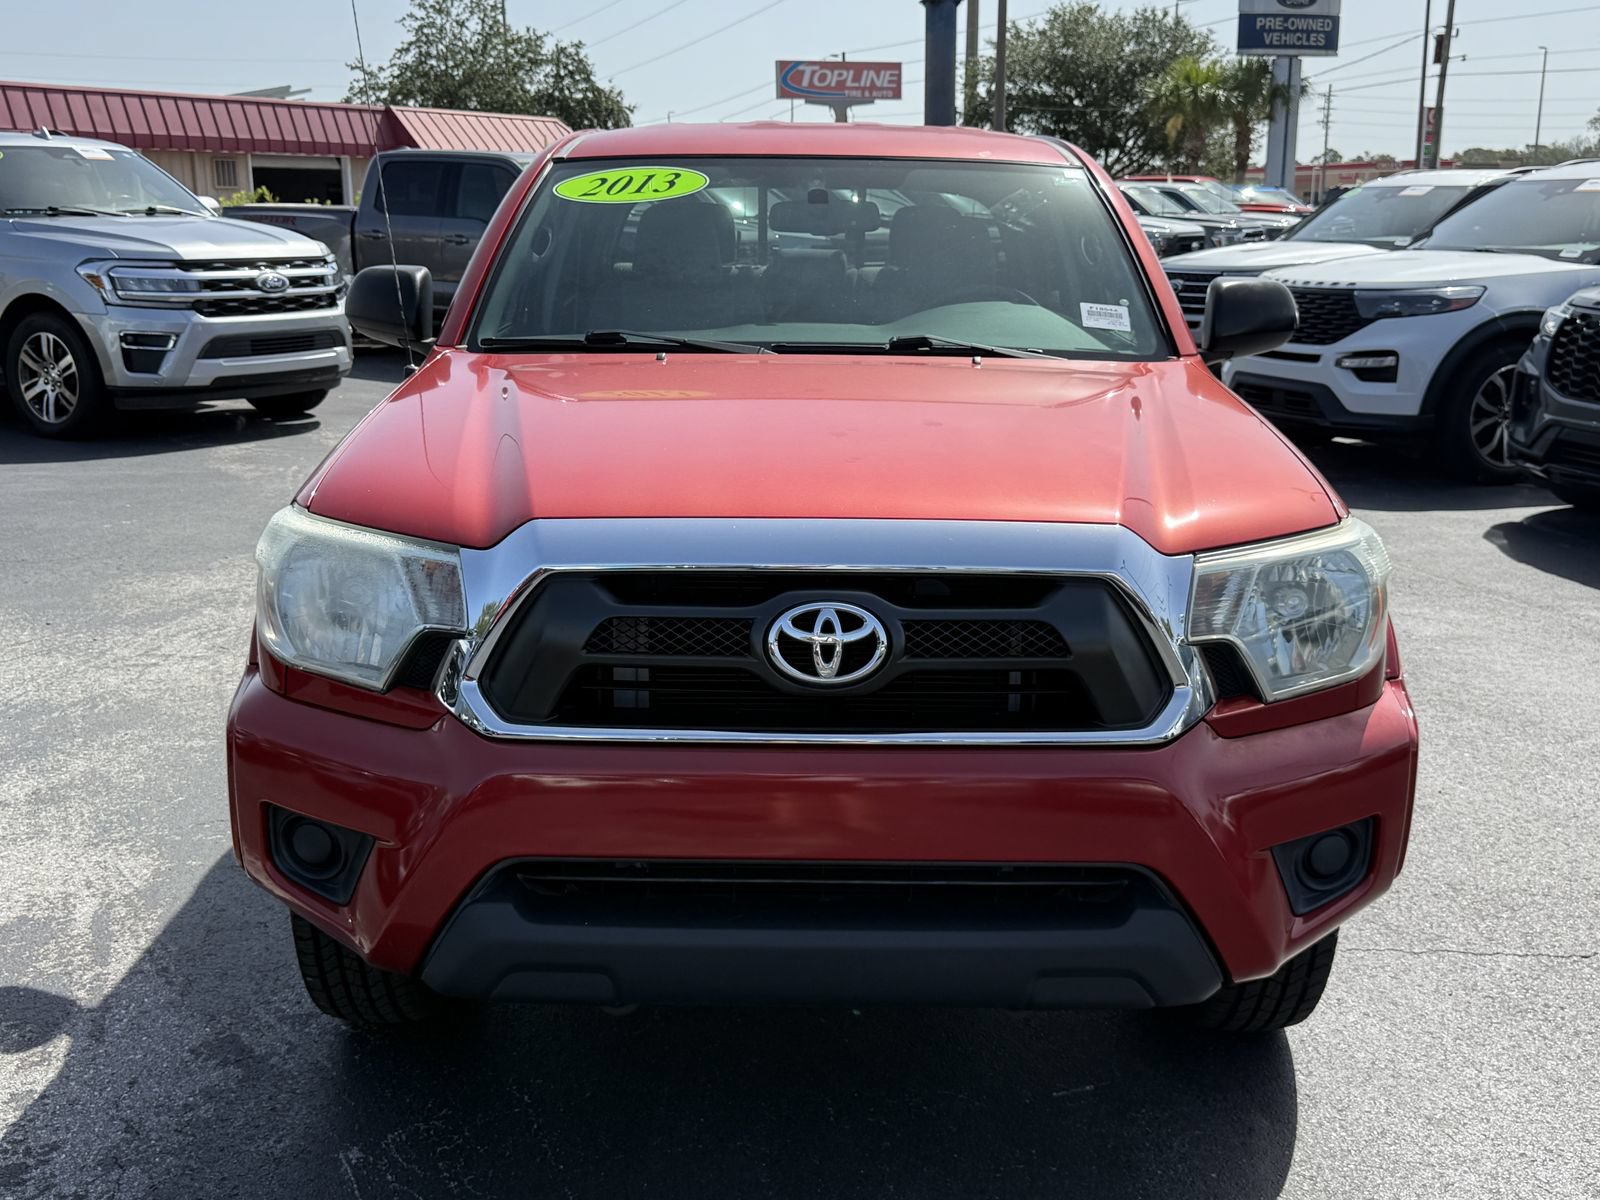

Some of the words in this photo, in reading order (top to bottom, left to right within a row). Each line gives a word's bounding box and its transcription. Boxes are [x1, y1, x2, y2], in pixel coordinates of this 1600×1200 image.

[1255, 17, 1333, 31] PRE-OWNED
[1263, 32, 1326, 46] VEHICLES
[799, 65, 899, 87] TOPLINE
[577, 172, 682, 197] 2013
